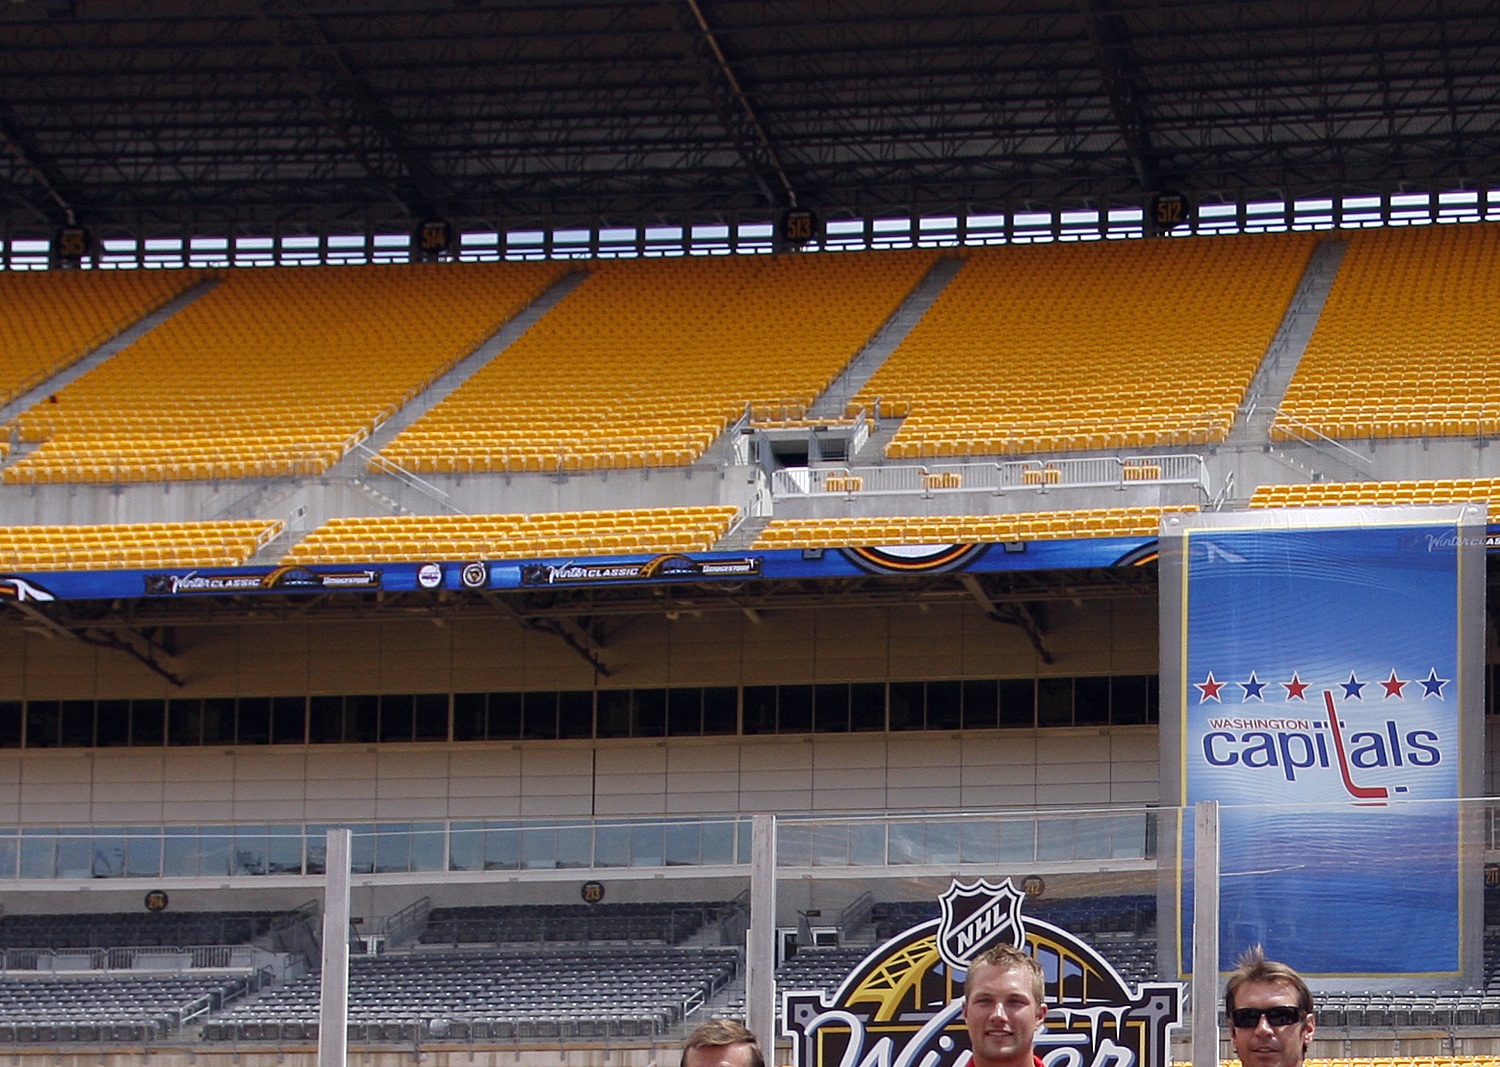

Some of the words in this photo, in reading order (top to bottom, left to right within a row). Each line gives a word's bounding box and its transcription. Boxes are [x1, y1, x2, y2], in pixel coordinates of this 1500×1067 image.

[1158, 201, 1181, 222] 512
[787, 217, 811, 238] 513
[588, 567, 639, 578] CLASSIC
[210, 578, 261, 588] CLASSIC
[1208, 718, 1310, 730] WASHINGTON
[1202, 690, 1442, 799] capitals
[1485, 870, 1499, 884] 211
[585, 887, 600, 900] 213
[1024, 882, 1040, 895] 212
[956, 902, 1008, 955] NHL
